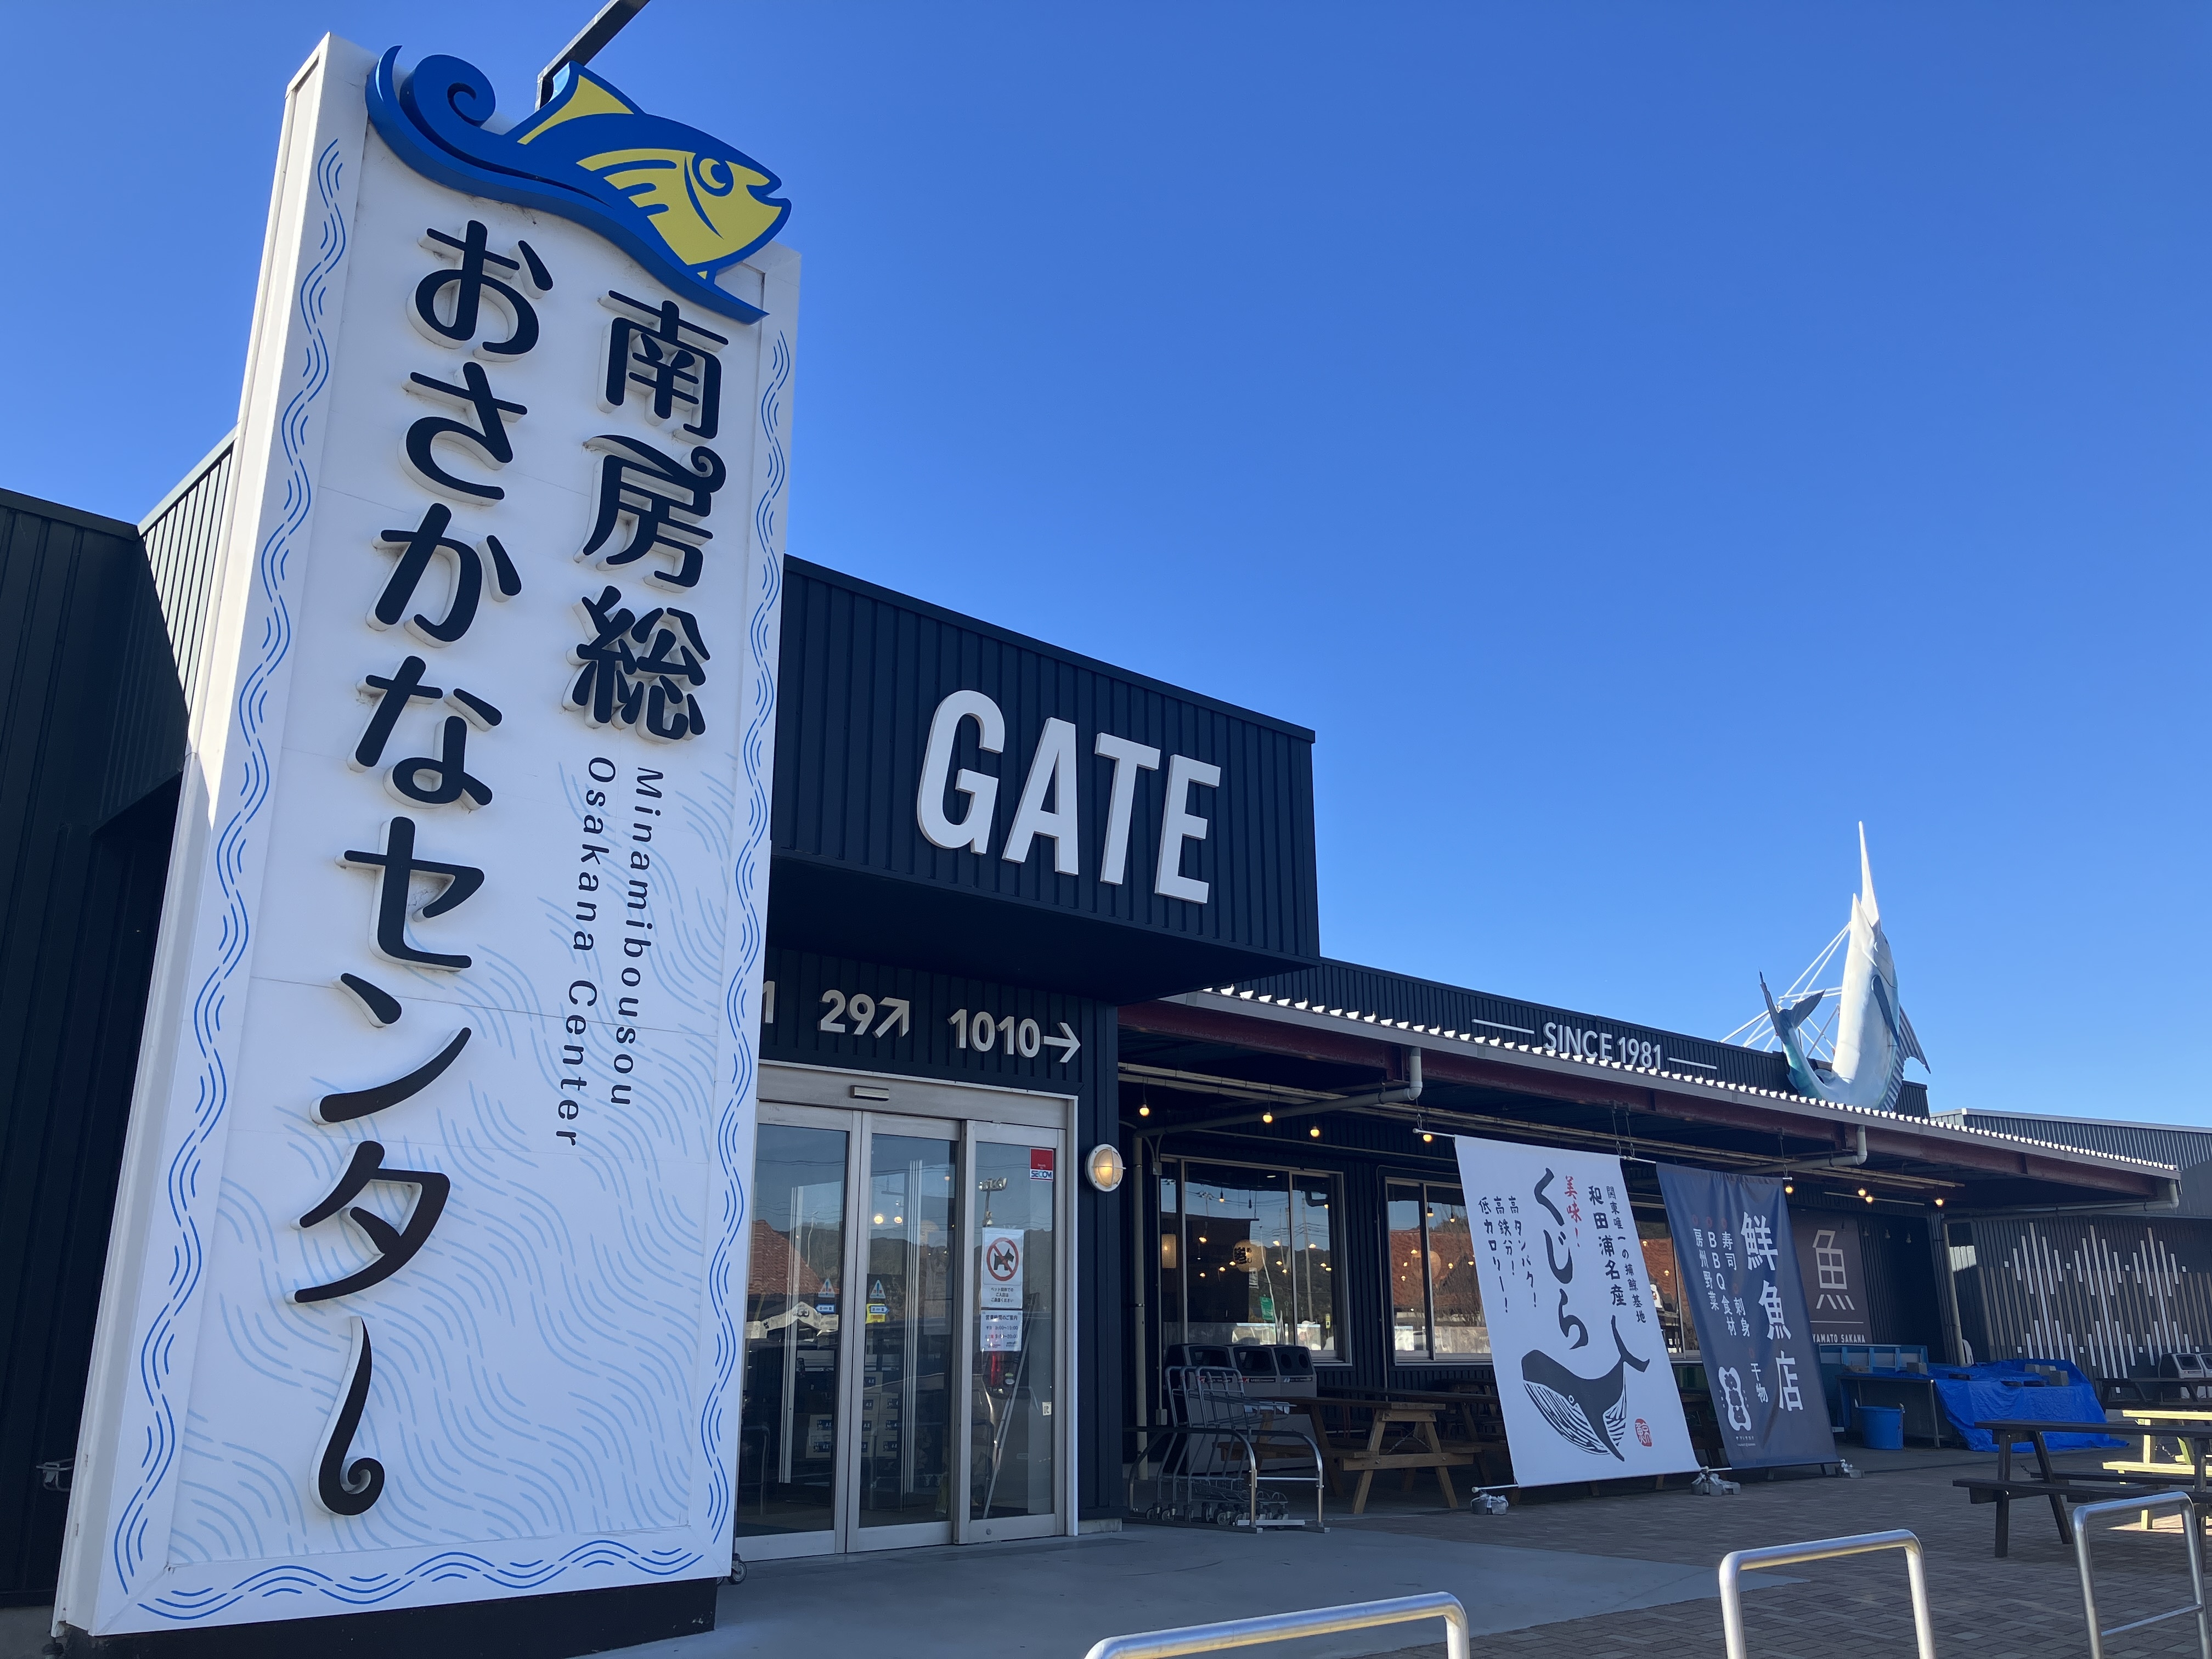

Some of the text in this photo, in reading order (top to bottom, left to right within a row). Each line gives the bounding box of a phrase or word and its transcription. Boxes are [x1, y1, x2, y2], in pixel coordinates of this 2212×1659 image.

[569, 290, 729, 741] 南房総
[290, 221, 553, 1516] おさかなセンター
[917, 690, 1221, 904] GATE
[556, 757, 616, 1146] Osakana Center
[611, 767, 663, 1106] Minamibousou
[947, 1008, 1041, 1058] 1010
[1543, 1022, 1661, 1070] SINCE 1981
[1031, 1170, 1052, 1178] SECOM
[1589, 1186, 1627, 1306] 和田浦名産
[1534, 1167, 1589, 1350] くじら
[1693, 1228, 1720, 1311] 房州野菜
[1708, 1232, 1737, 1336] BBQ食材
[1722, 1231, 1769, 1403] 寿司 刺身 干物
[1741, 1211, 1803, 1412] 鮮魚店
[1812, 1229, 1855, 1311] 魚
[1812, 1333, 1866, 1343] YAMATO SAKANA
